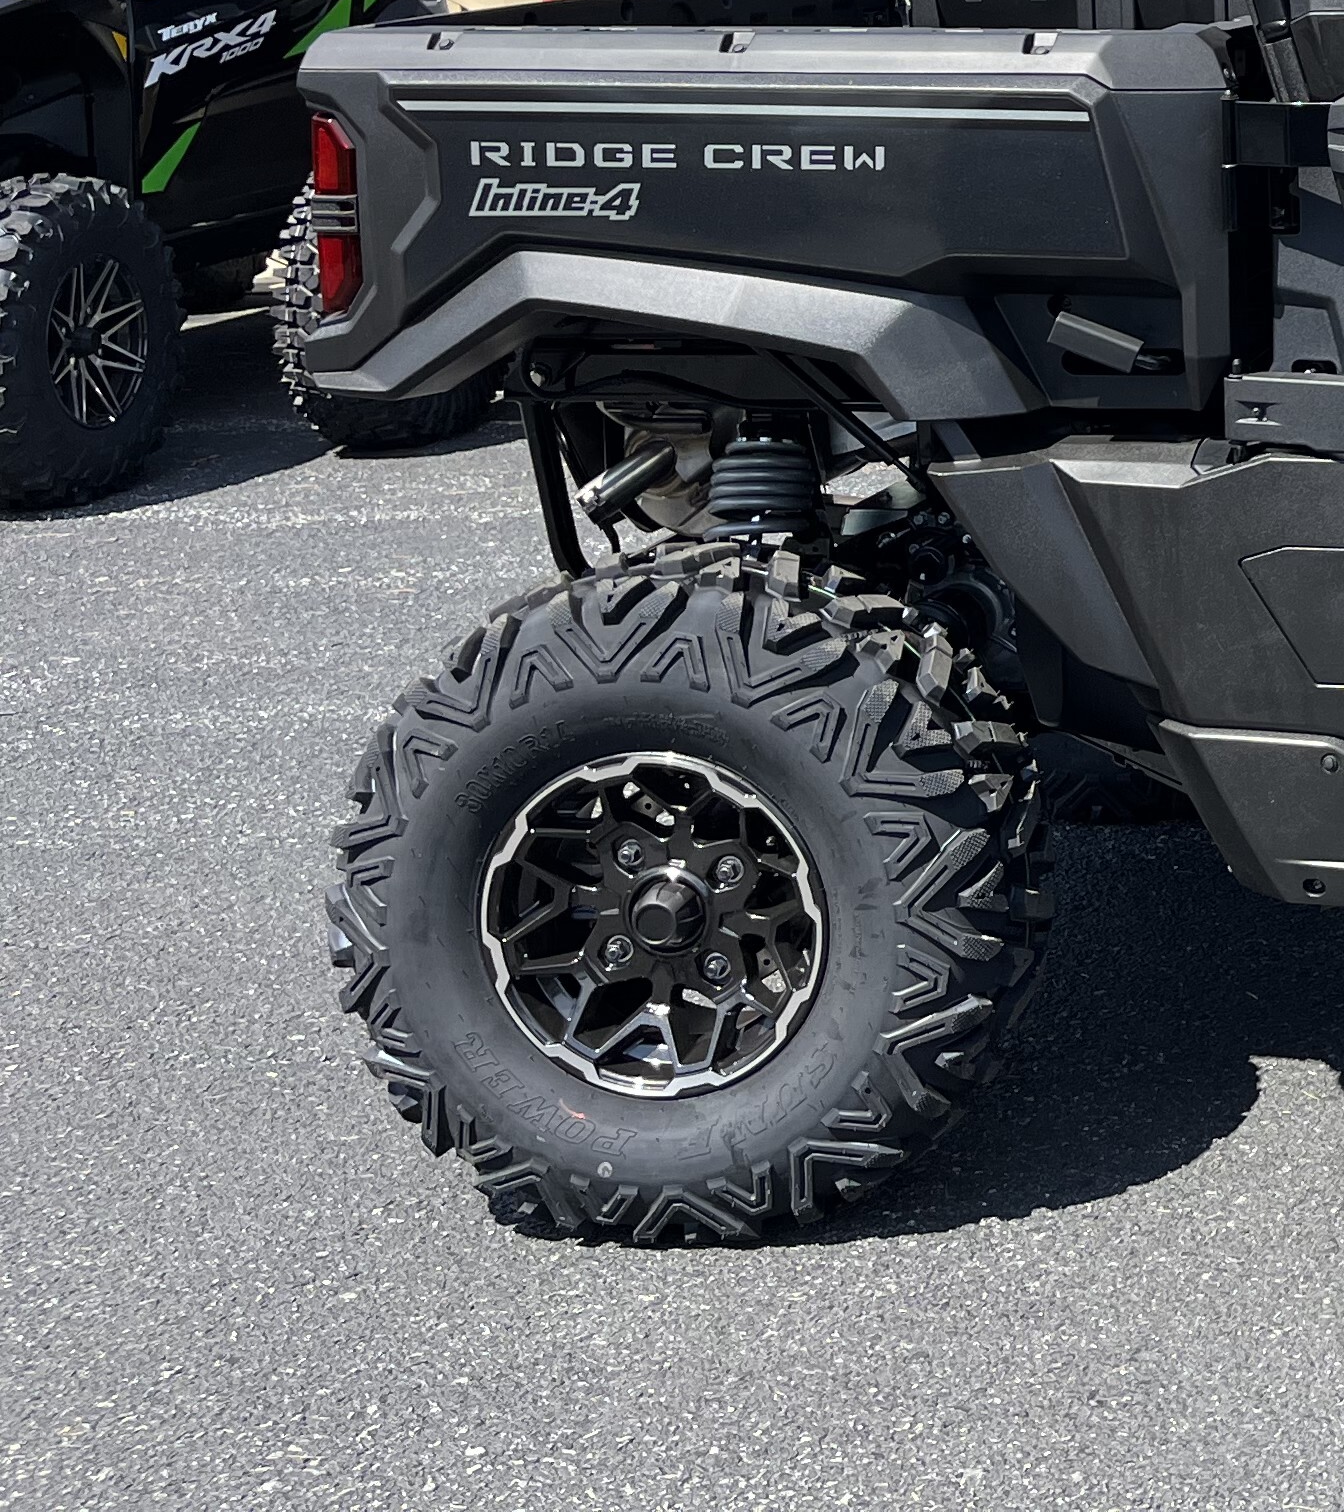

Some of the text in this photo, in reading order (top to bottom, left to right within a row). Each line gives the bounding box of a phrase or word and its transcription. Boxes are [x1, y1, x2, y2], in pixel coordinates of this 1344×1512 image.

[144, 9, 277, 88] KRX4
[219, 37, 265, 64] 1000
[469, 141, 886, 171] RIDGE CREW
[468, 178, 641, 220] Inline-4
[453, 1031, 638, 1157] POWER
